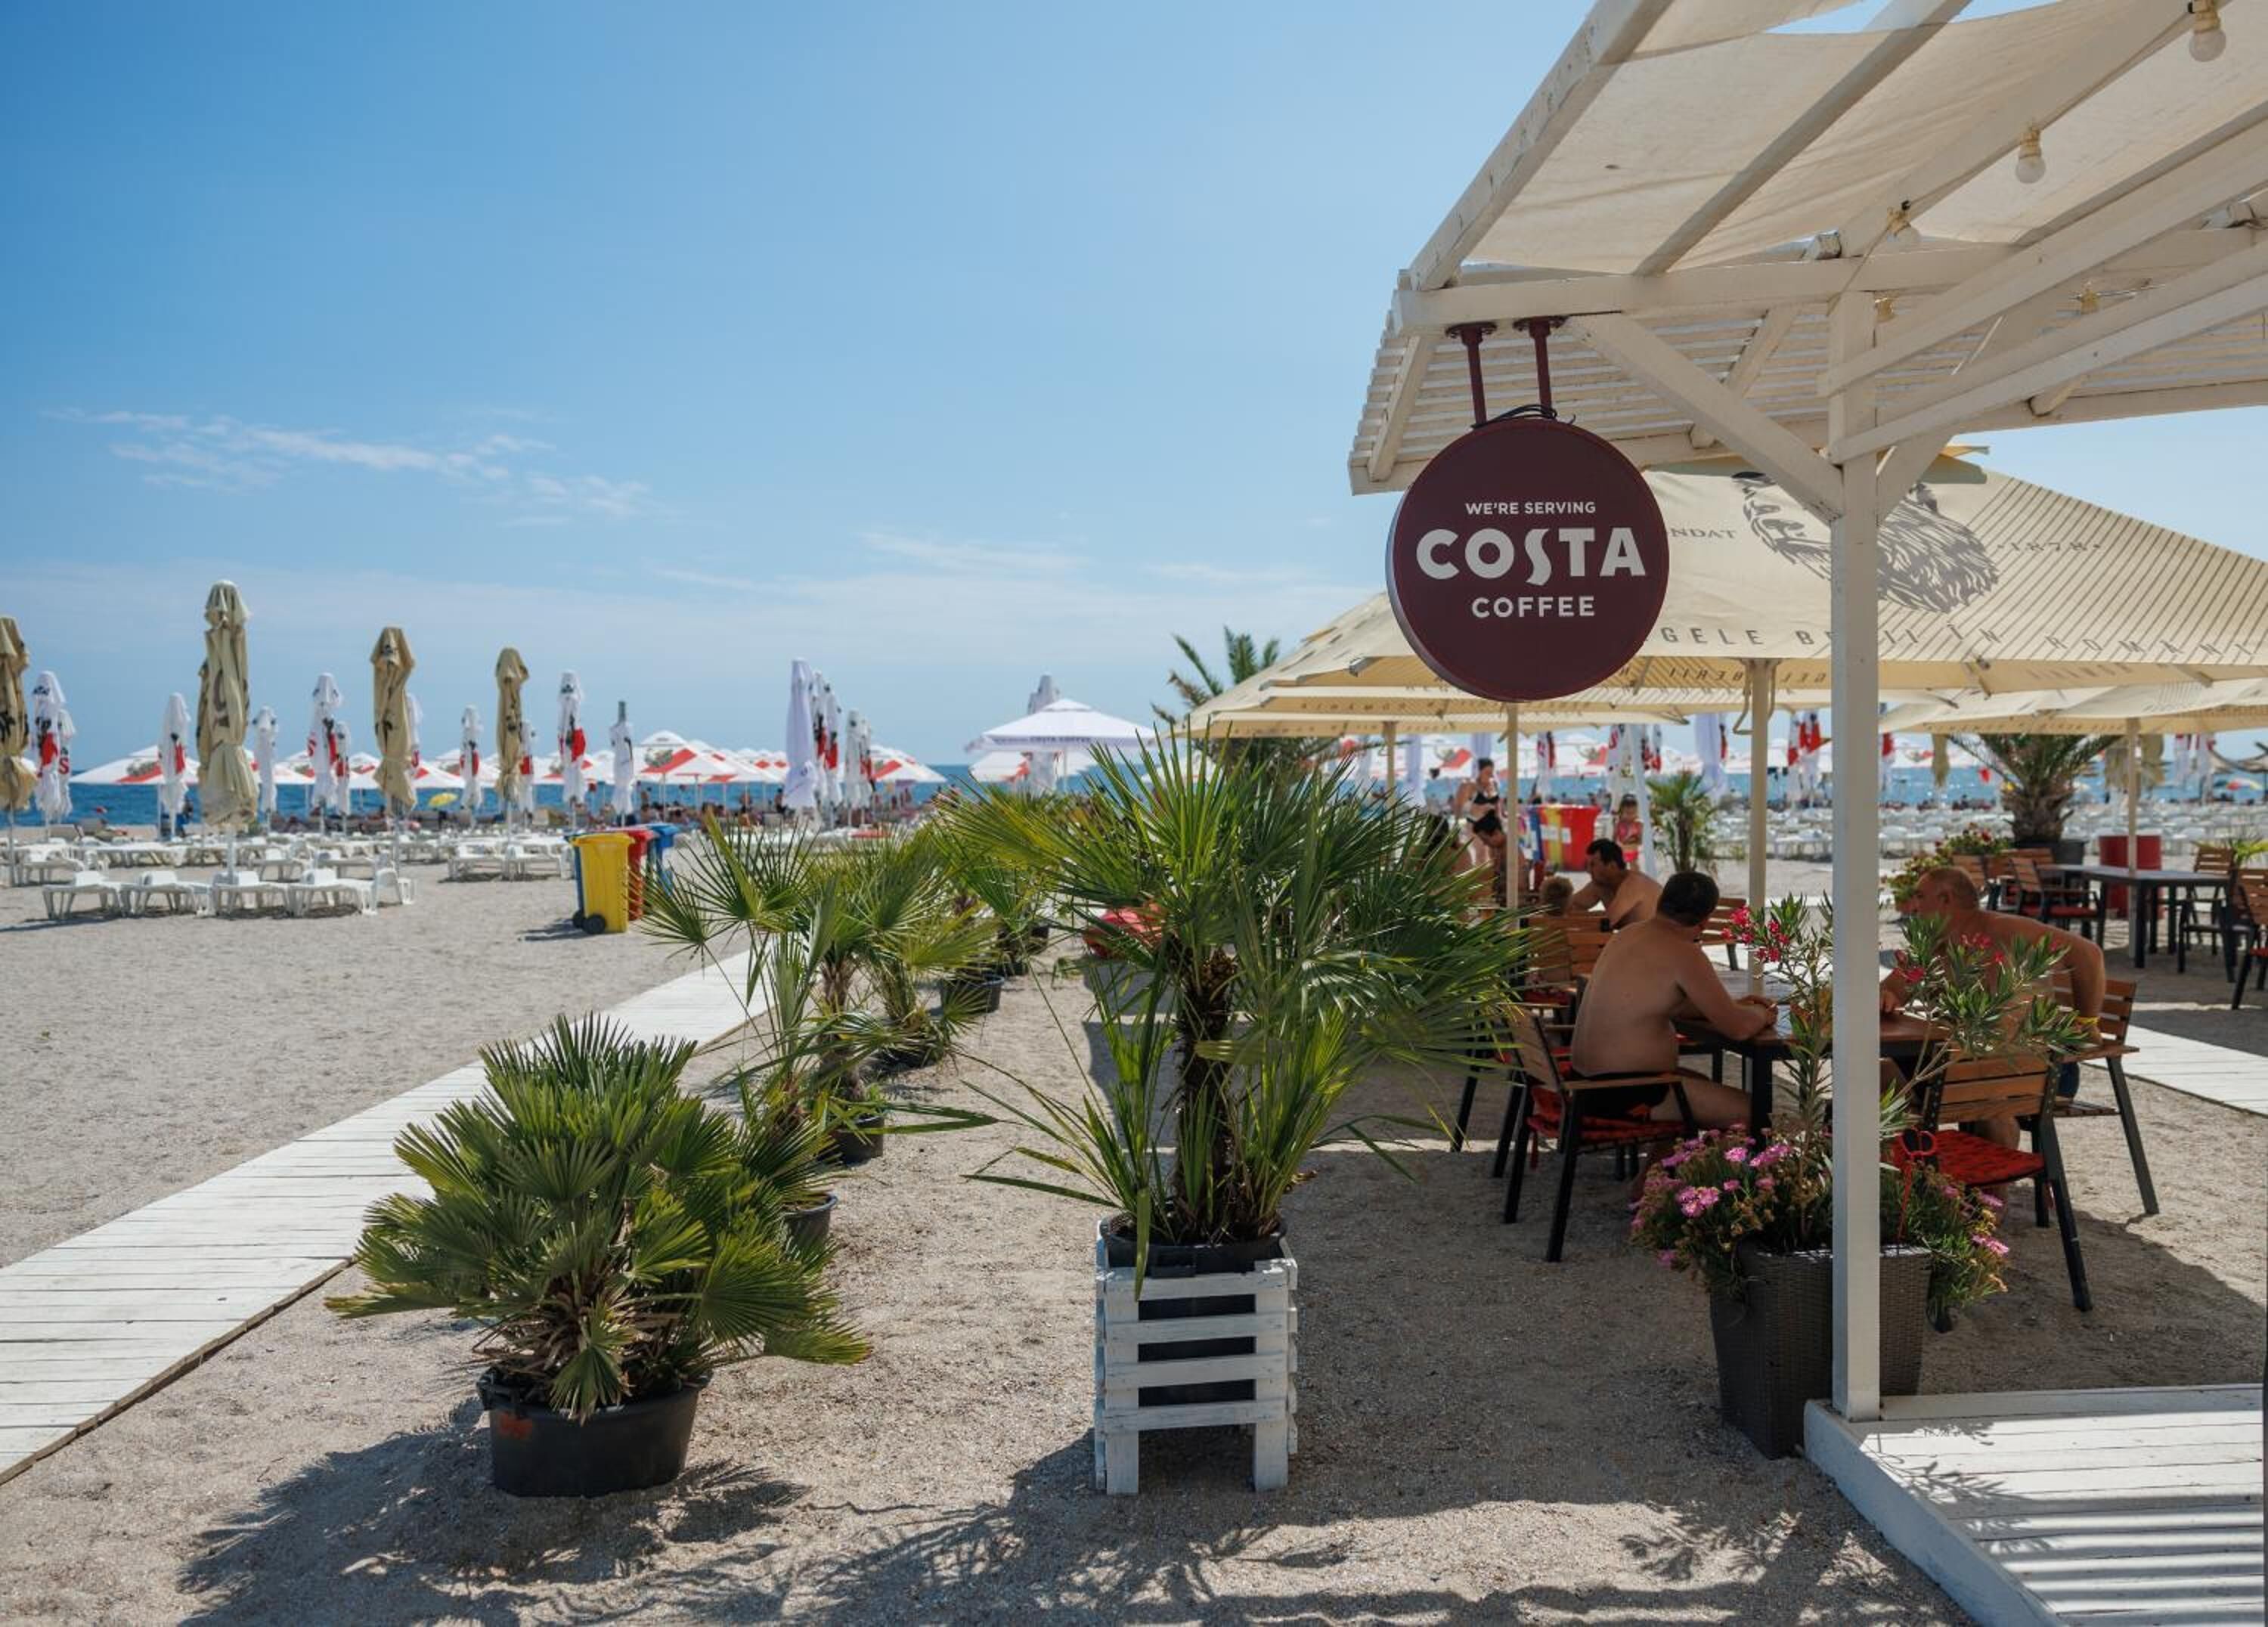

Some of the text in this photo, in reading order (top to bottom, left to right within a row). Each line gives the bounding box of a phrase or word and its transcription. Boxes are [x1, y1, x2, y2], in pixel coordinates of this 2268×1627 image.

[1465, 501, 1597, 515] WE'RE SERVING
[1670, 528, 1736, 539] NDAT
[1416, 528, 1646, 586] COSTA
[1471, 596, 1595, 618] COFFEE
[1645, 627, 1765, 645] GELE
